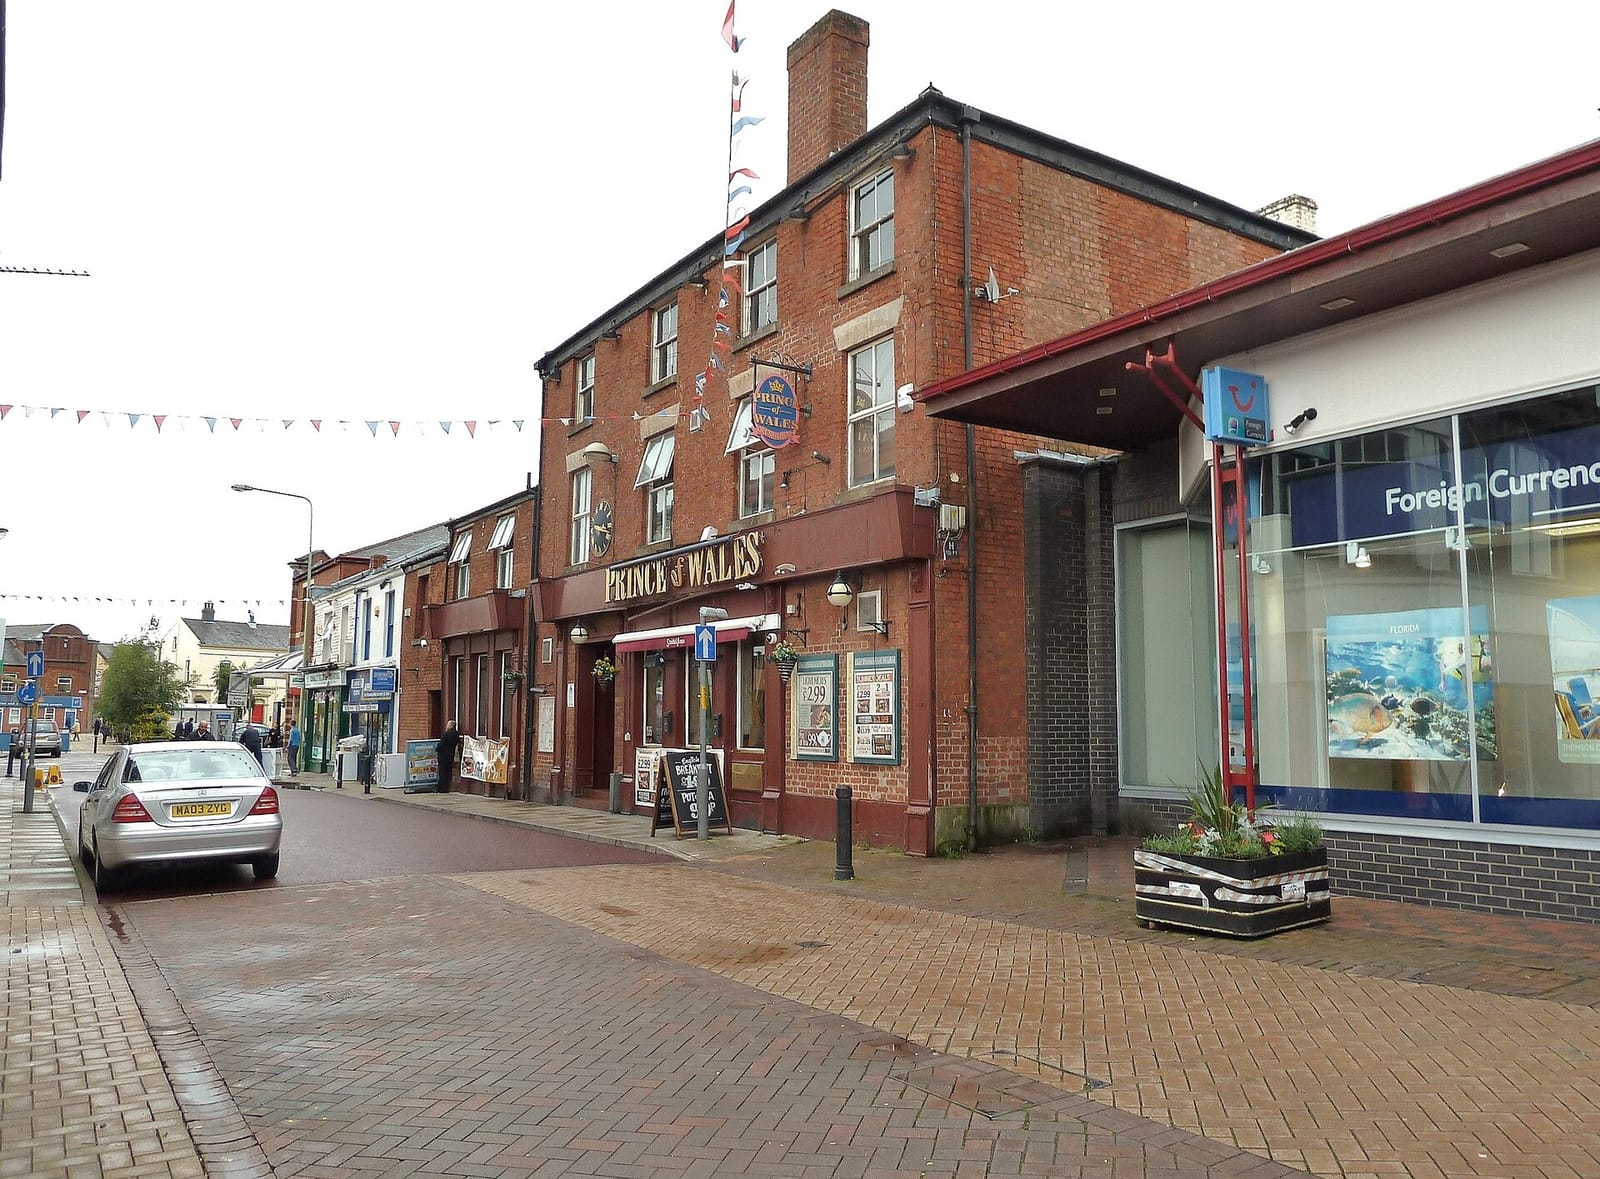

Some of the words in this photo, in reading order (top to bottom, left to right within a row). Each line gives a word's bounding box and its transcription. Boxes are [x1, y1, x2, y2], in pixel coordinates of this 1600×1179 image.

[754, 413, 799, 430] WALES
[1385, 480, 1482, 515] Foreign
[604, 559, 667, 603] PRINCE
[688, 531, 761, 588] WALES
[1389, 623, 1420, 634] FLORIDA
[676, 764, 712, 775] BREAKT
[176, 804, 204, 816] MA03
[206, 803, 227, 815] ZYG
